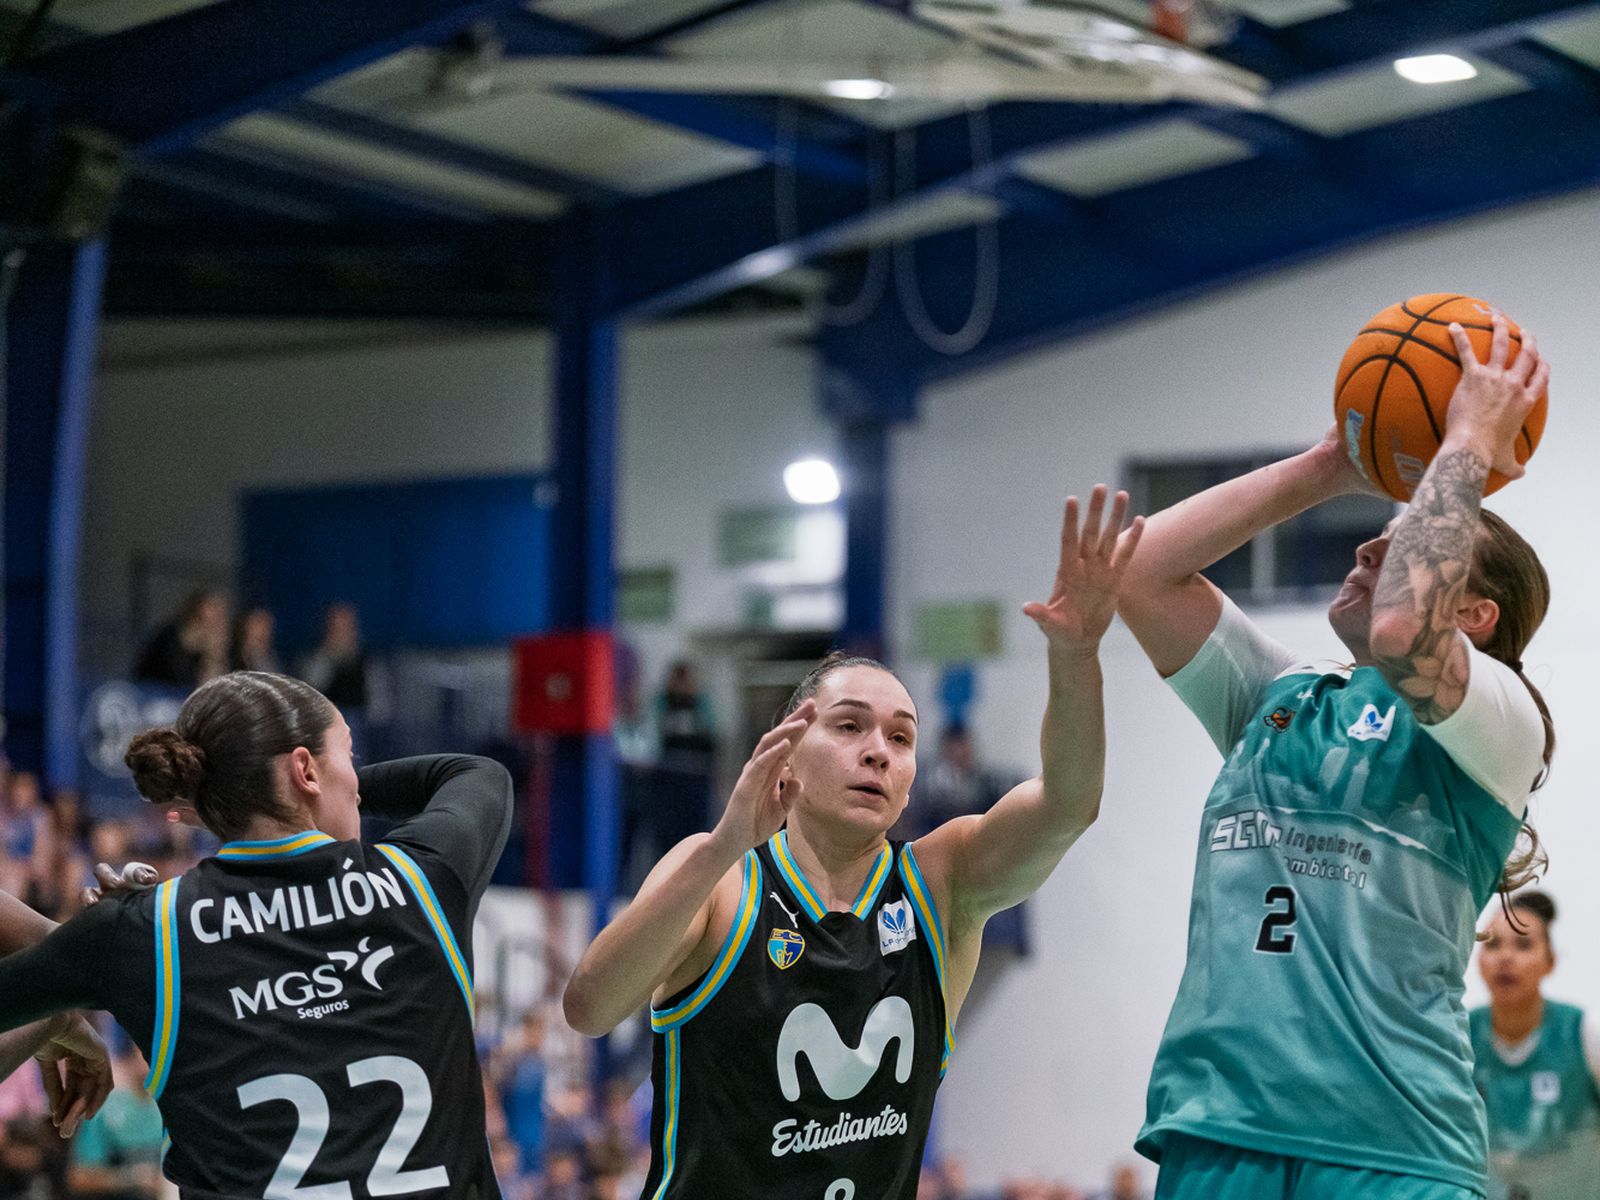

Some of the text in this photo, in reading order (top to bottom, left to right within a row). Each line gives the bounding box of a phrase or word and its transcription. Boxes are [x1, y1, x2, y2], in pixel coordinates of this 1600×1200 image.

[189, 857, 407, 944] CAMILIÓN
[1253, 884, 1299, 956] 2
[228, 963, 344, 1020] MGS
[297, 999, 350, 1019] Seguros
[771, 1104, 908, 1157] Estudiantes
